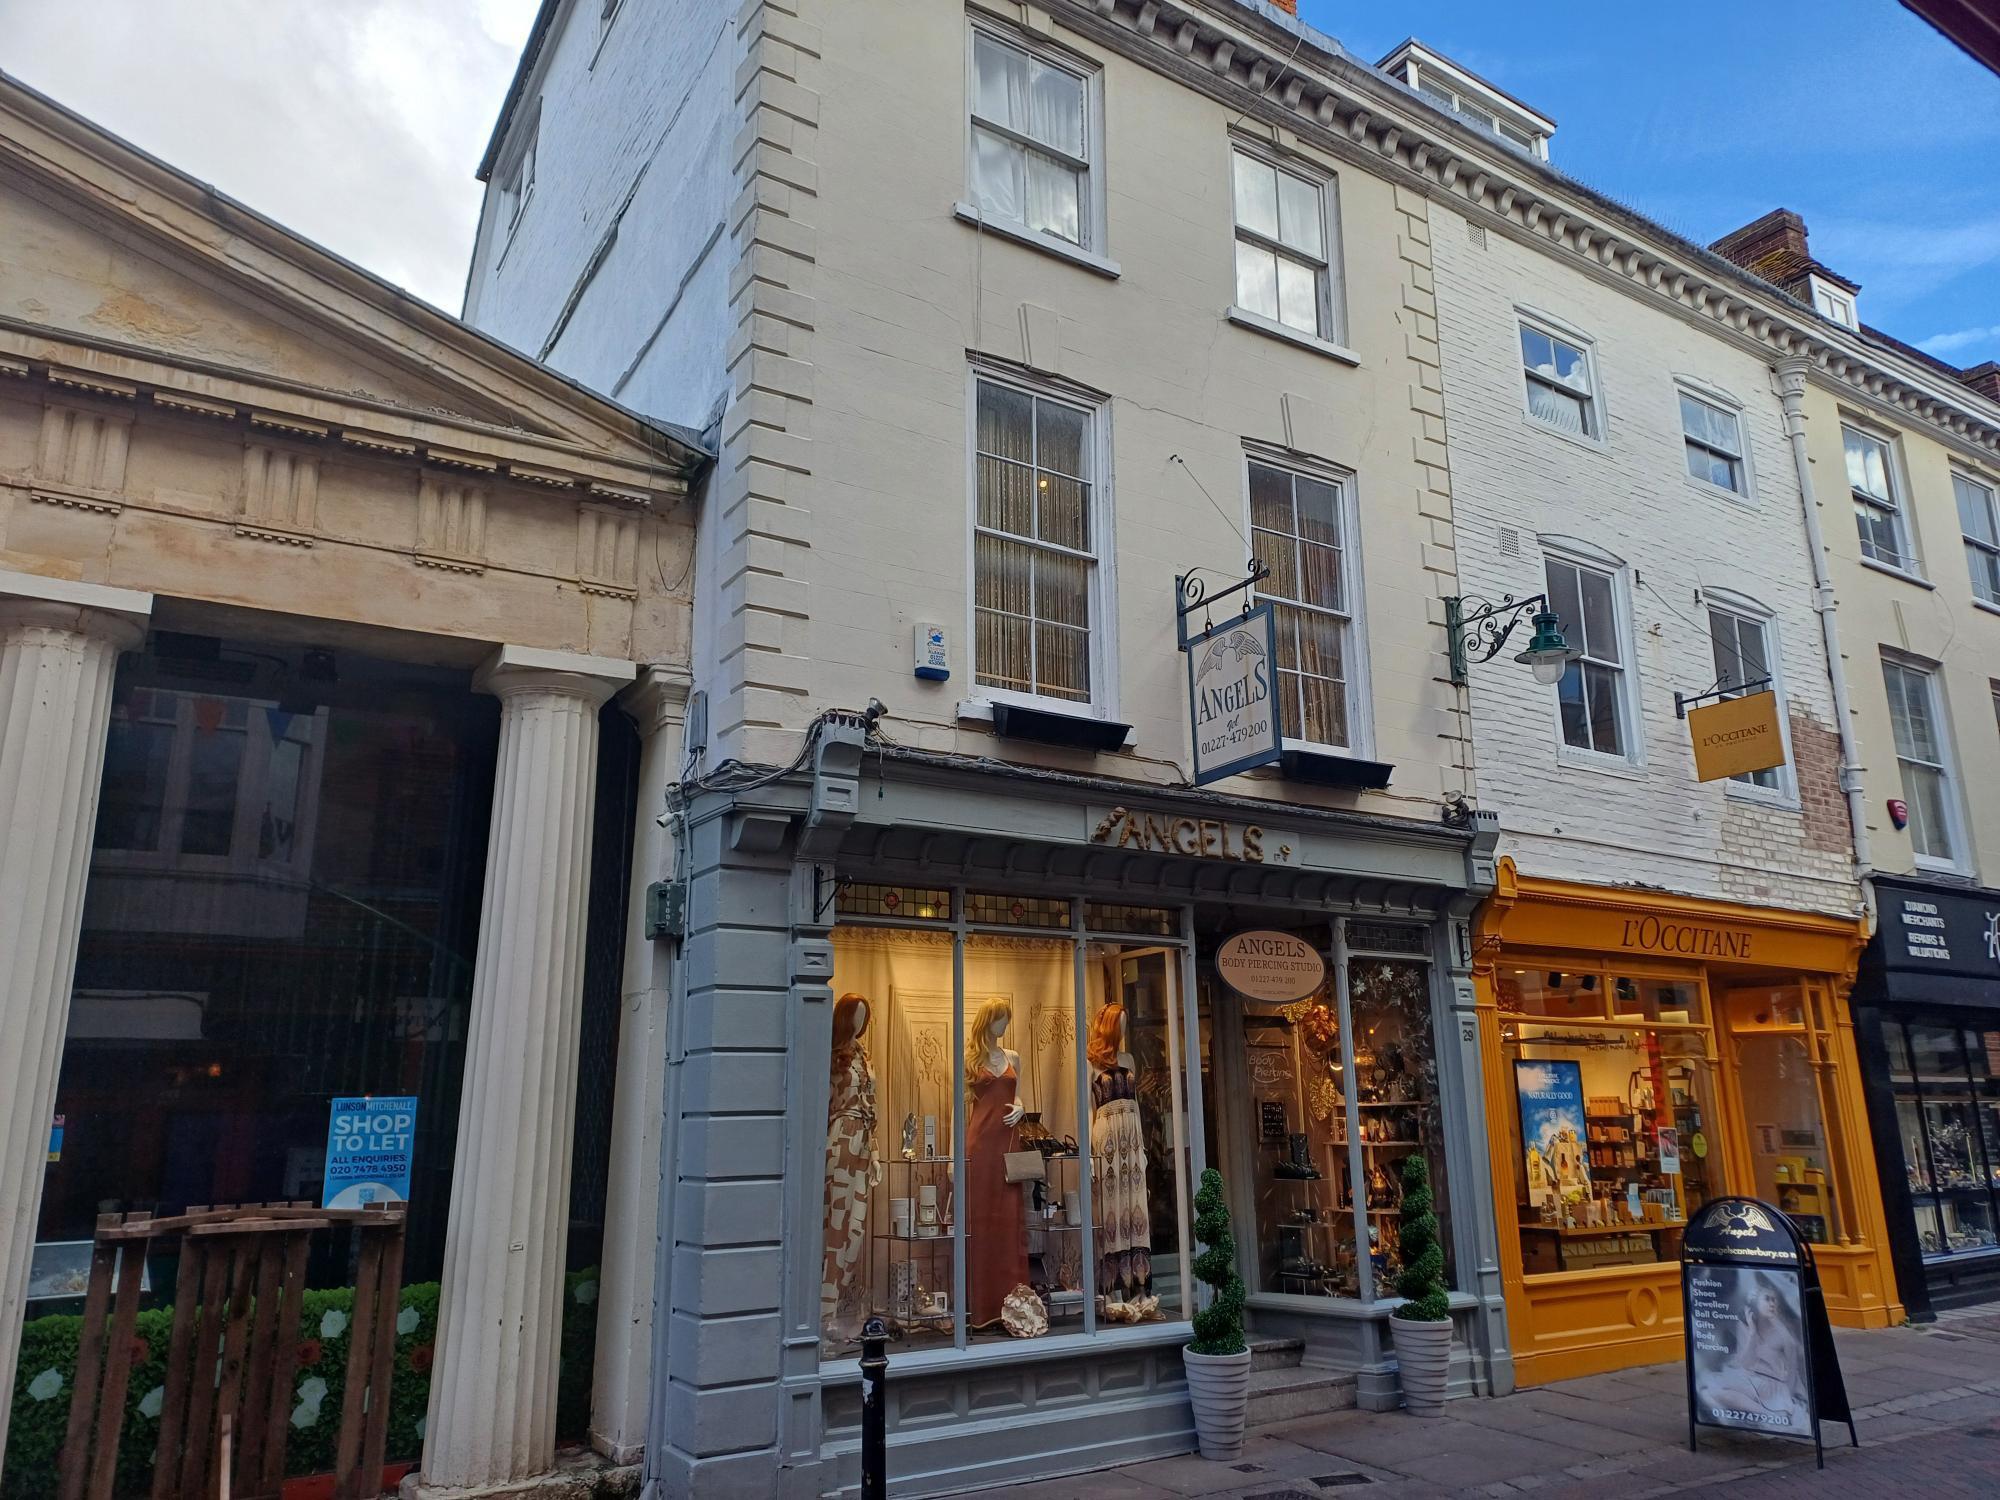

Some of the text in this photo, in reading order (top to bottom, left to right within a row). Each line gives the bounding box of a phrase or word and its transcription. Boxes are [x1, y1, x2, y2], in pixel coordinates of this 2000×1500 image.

[1197, 657, 1268, 725] ANGELS
[1703, 723, 1769, 747] L'OCCITANE
[1118, 810, 1265, 864] ANGELS
[1901, 913, 1946, 929] MERCHANTS
[1621, 915, 1753, 959] L'OCCITANE
[1236, 937, 1306, 959] ANGELS
[1222, 957, 1322, 973] BODY PIERCING STUDIO
[1462, 1029, 1474, 1042] 29
[334, 1114, 411, 1135] SHOP
[333, 1134, 410, 1152] TO LET
[331, 1156, 349, 1164] ALL
[330, 1164, 406, 1175] 020 7478 4950
[1719, 1225, 1758, 1239] Angels
[1693, 1279, 1722, 1288] Fashion
[1693, 1289, 1716, 1297] Shoes
[1694, 1299, 1730, 1311] Jewellery
[1695, 1310, 1738, 1320] Ball Gowns
[1696, 1321, 1715, 1329] Gifts
[1696, 1331, 1715, 1341] Body
[1697, 1342, 1729, 1354] Piercing
[1712, 1408, 1789, 1425] 01227479200
